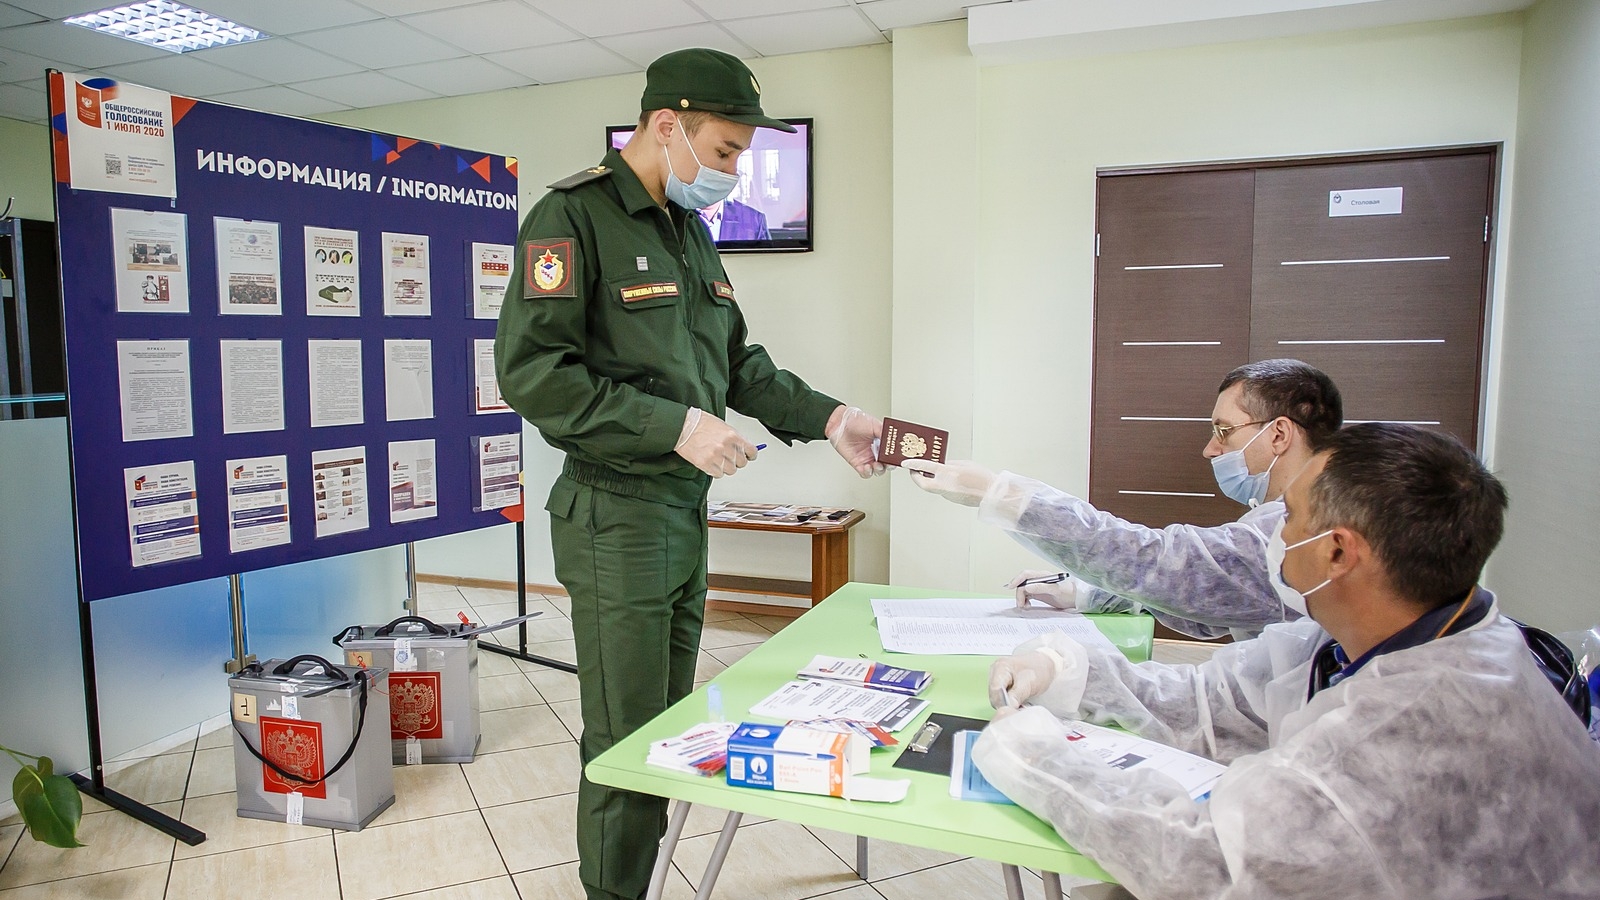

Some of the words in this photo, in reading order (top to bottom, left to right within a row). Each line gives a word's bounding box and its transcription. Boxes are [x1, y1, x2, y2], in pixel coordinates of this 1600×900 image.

[104, 102, 163, 118] ОБЩЕРОССИЙСКОЕ
[105, 111, 164, 128] ГОЛОСОВАНИЕ
[106, 120, 111, 130] 1
[114, 121, 141, 134] ИЮЛЯ
[143, 126, 165, 138] 2020
[196, 148, 372, 193] ИНФОРМАЦИЯ
[391, 176, 517, 212] INFORMATION
[931, 435, 943, 462] АСПОРТ
